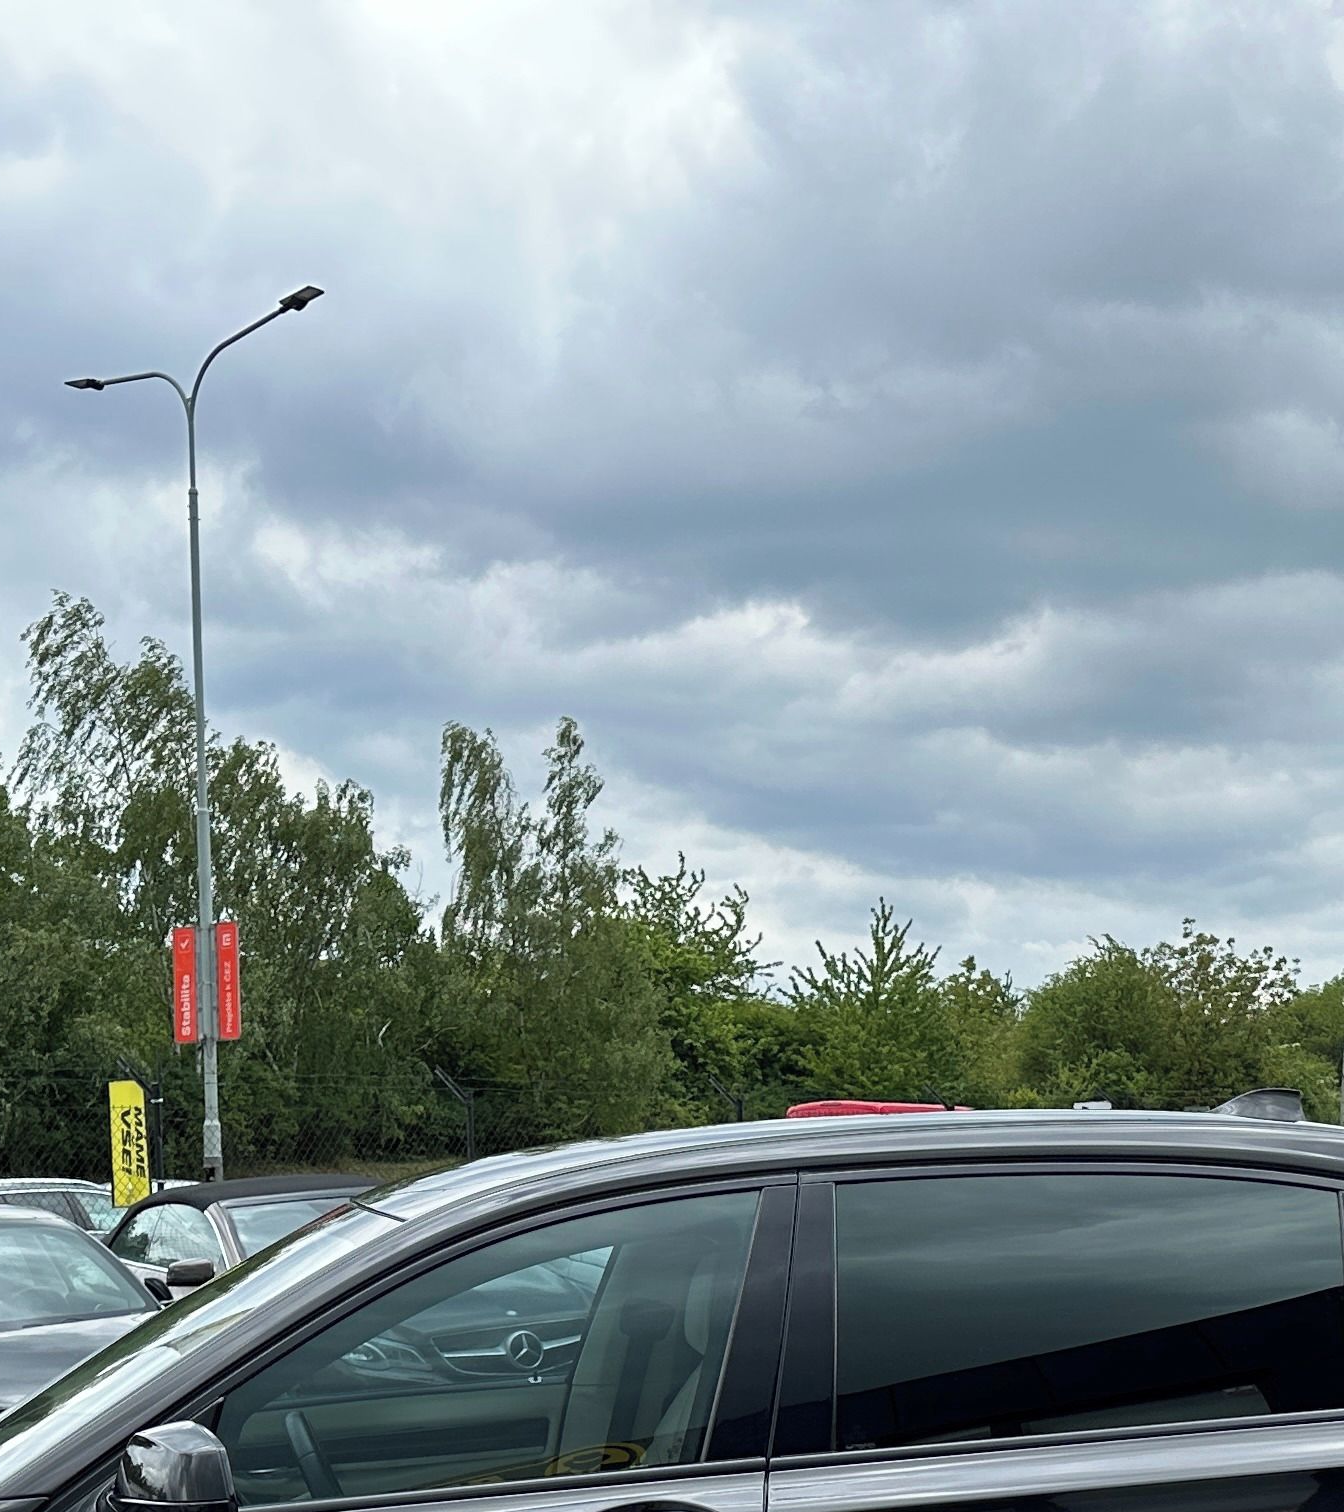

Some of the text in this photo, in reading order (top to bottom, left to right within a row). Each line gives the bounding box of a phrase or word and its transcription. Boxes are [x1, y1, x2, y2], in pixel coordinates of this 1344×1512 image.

[180, 974, 191, 1036] Stabilita
[120, 1108, 135, 1176] VŠE!
[133, 1106, 147, 1178] MÁME
